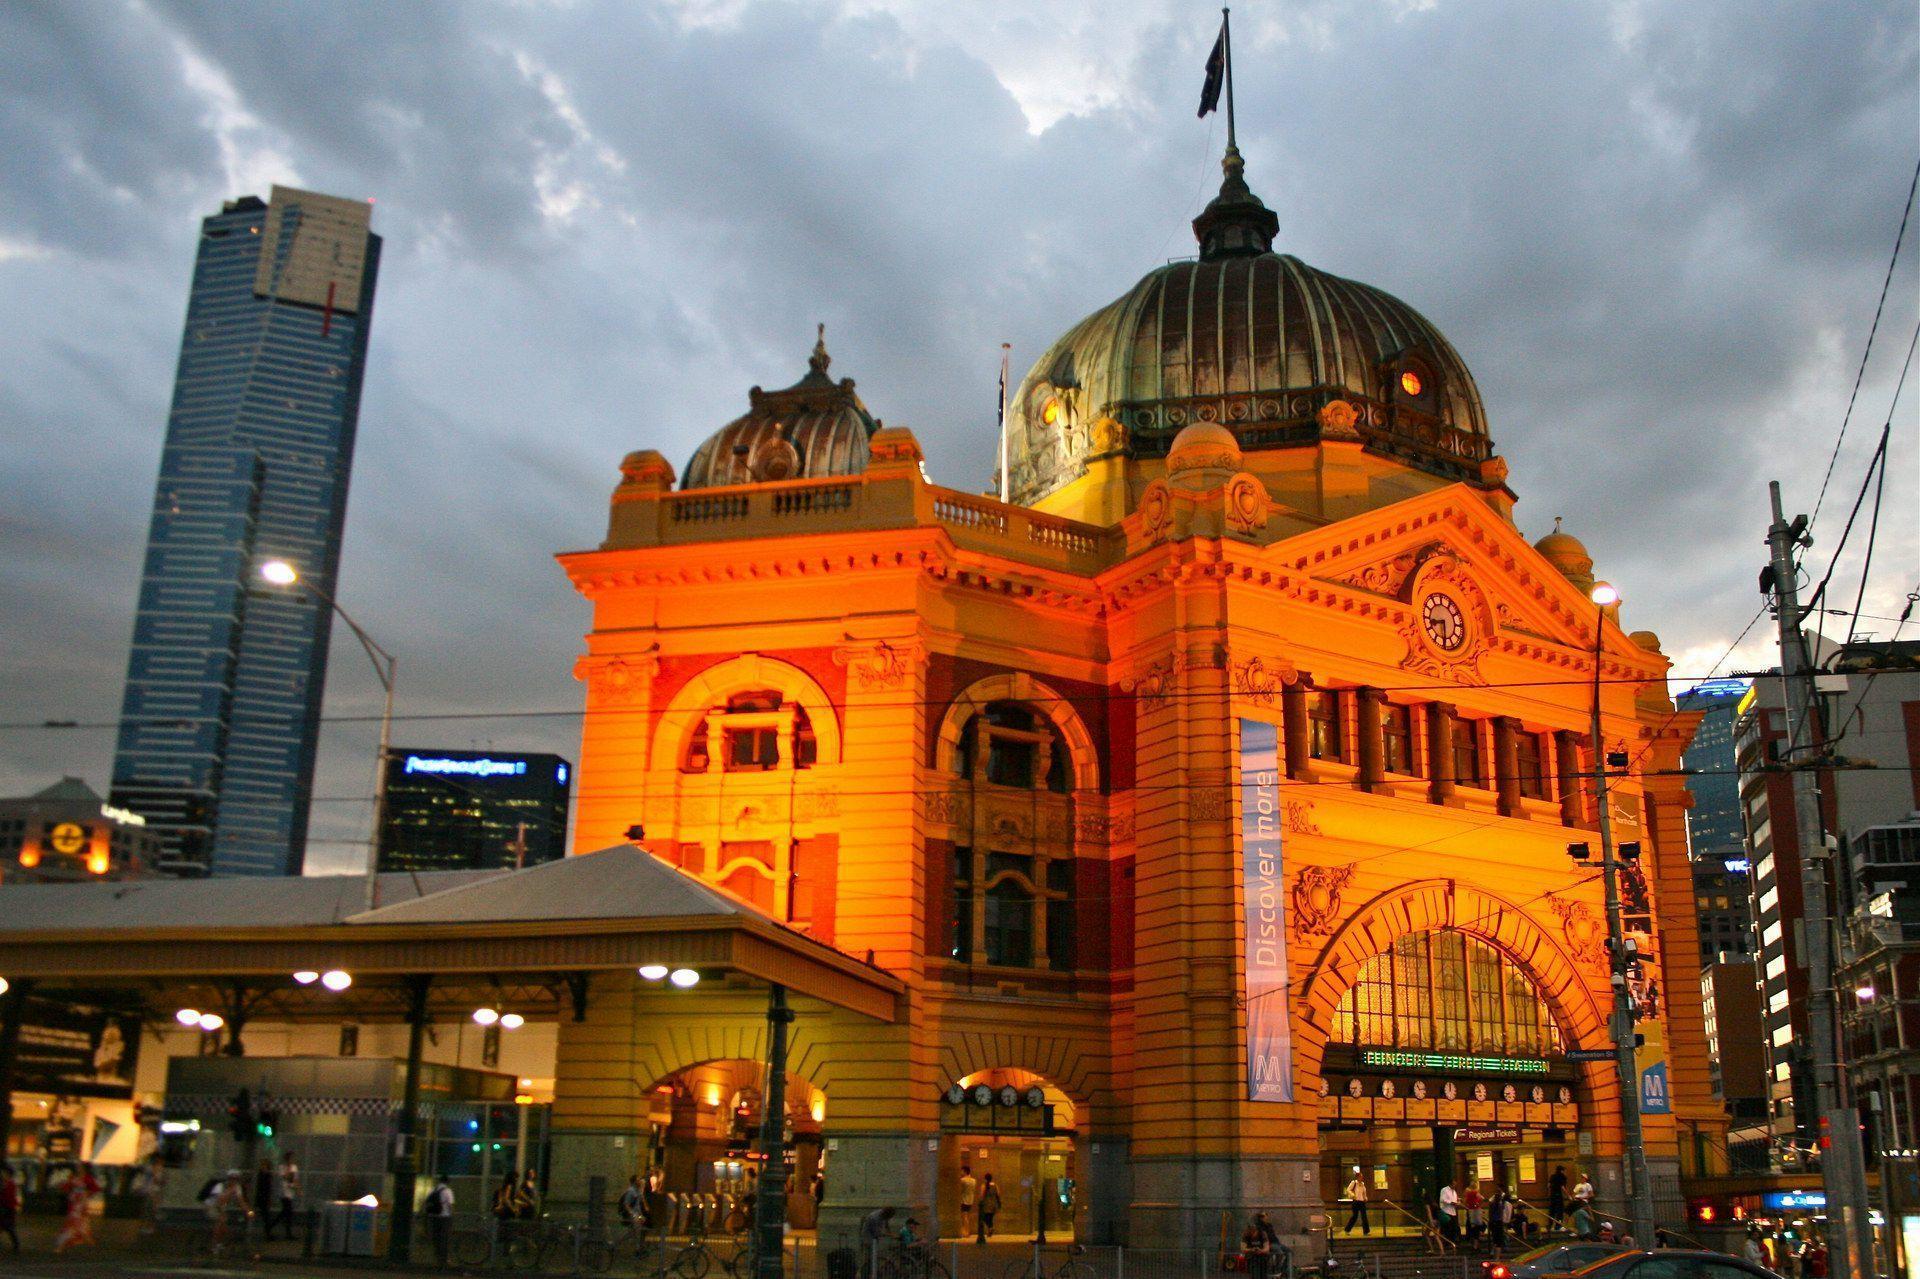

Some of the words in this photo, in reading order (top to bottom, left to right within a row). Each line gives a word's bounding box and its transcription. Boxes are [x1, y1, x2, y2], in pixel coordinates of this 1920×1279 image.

[1257, 772, 1273, 840] more
[1256, 848, 1277, 967] Discover
[1367, 1051, 1427, 1068] FLINDERS
[1443, 1056, 1483, 1071] STREET
[1500, 1058, 1551, 1074] STATION
[1468, 1130, 1495, 1141] Regional
[1495, 1129, 1518, 1138] Tickets
